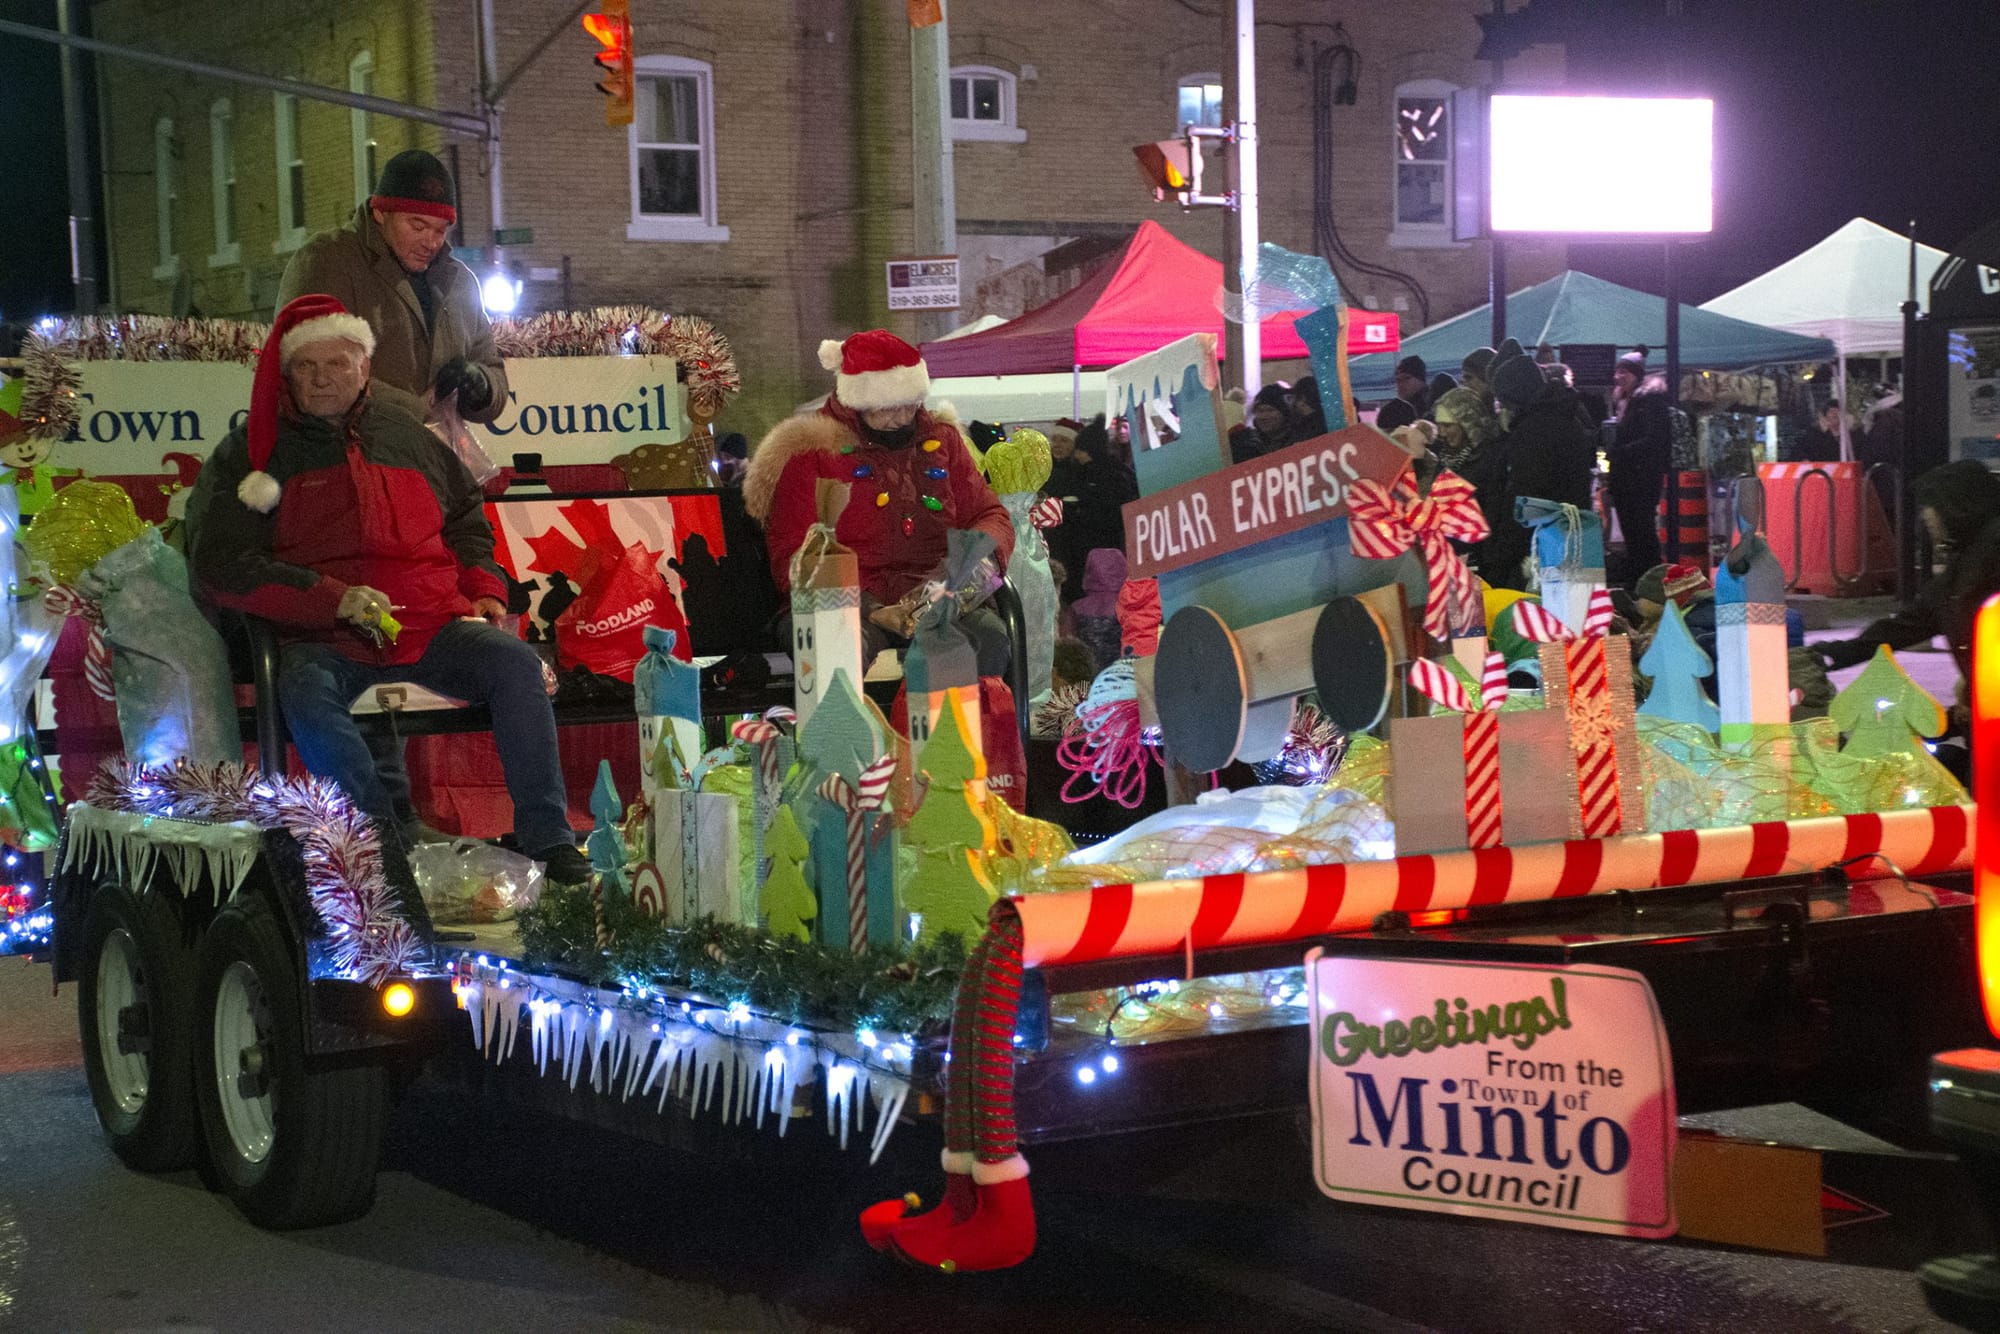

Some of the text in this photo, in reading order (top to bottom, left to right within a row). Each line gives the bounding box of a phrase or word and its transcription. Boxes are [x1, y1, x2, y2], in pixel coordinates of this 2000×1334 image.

[485, 384, 670, 436] Council
[1135, 443, 1359, 566] POLAR EXPRESS
[576, 598, 655, 635] FOODLAND
[1322, 977, 1572, 1066] Greetings!
[1462, 1078, 1590, 1111] Town of
[1487, 1051, 1624, 1087] From the
[1345, 1071, 1629, 1176] Minto
[1403, 1156, 1583, 1211] Council
